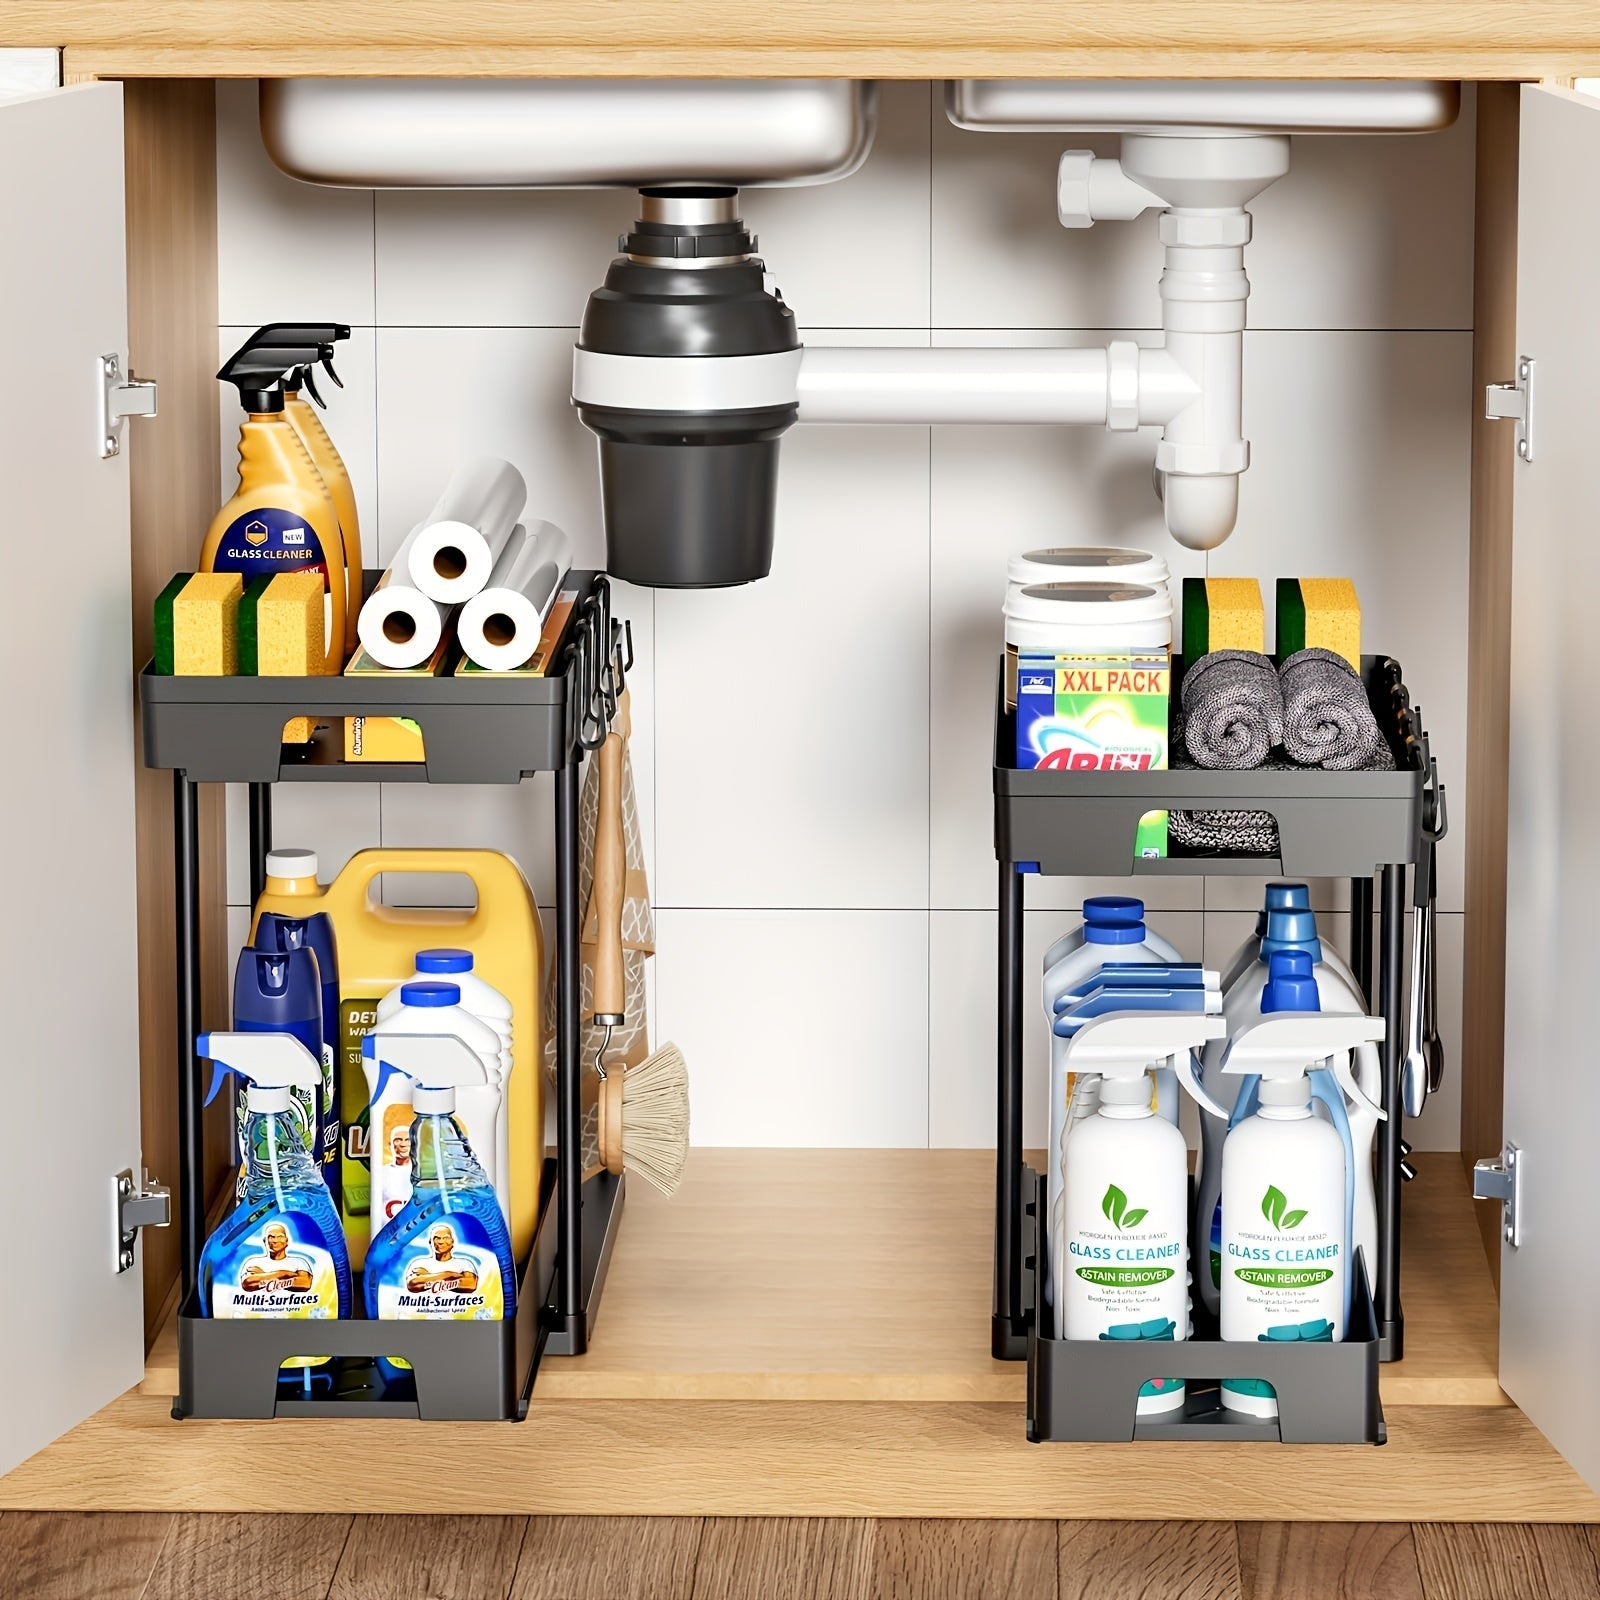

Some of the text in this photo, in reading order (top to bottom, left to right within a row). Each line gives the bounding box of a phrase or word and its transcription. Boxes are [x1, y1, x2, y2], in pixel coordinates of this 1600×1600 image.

[227, 548, 313, 559] GLASS CLEANER
[1063, 671, 1162, 693] XXL PACK
[1069, 1241, 1180, 1260] GLASS CLEANER
[1228, 1243, 1339, 1262] GLASS CLEANER
[1080, 1268, 1168, 1283] &STAIN REMOVER
[1240, 1269, 1327, 1283] &STAIN REMOVER
[266, 1279, 293, 1293] Clean
[431, 1280, 458, 1294] Clean
[233, 1294, 319, 1306] Multi-Surfaces
[398, 1295, 484, 1307] Multi-Surfaces
